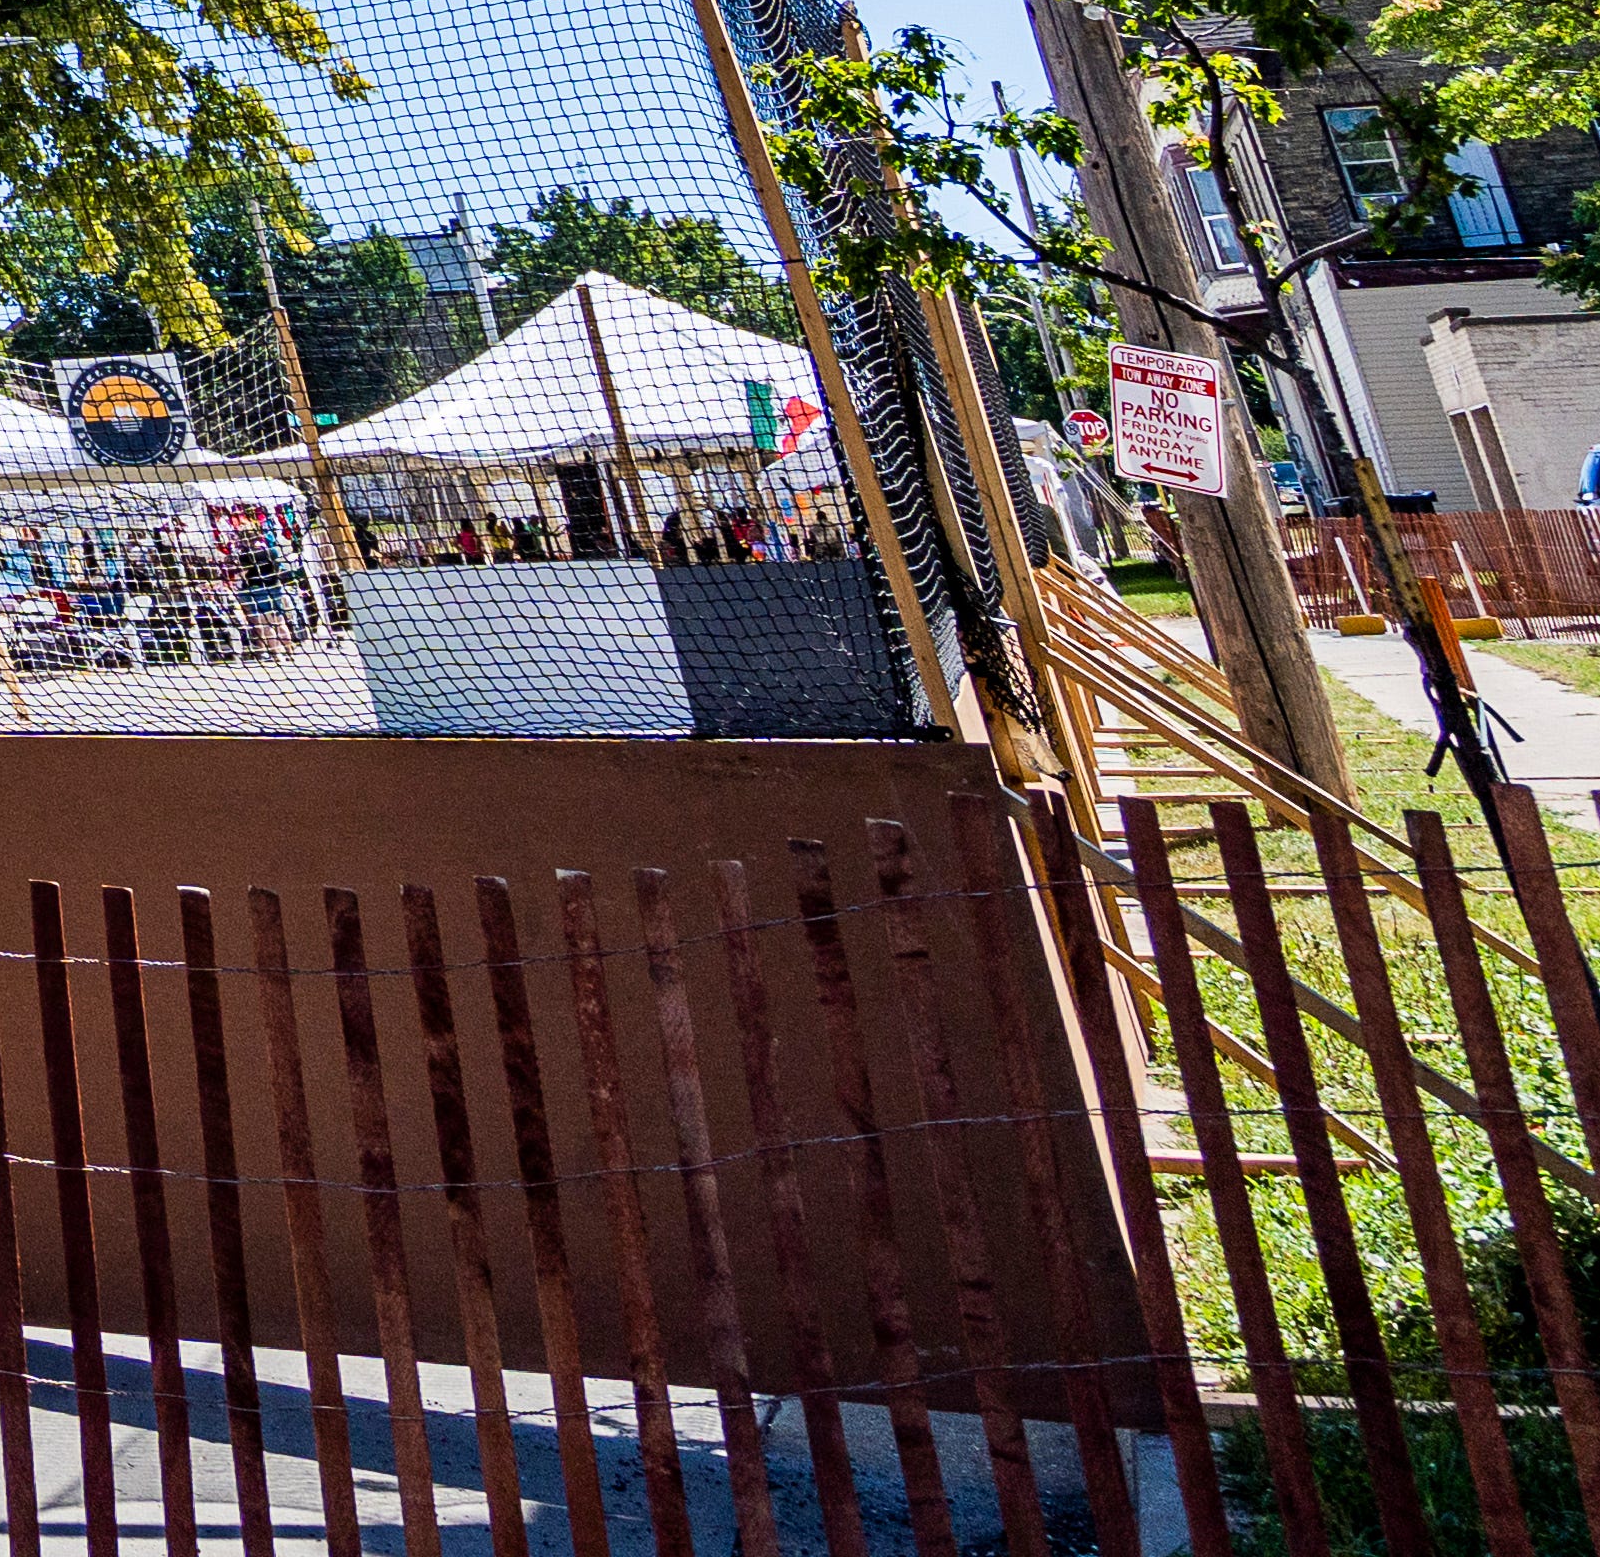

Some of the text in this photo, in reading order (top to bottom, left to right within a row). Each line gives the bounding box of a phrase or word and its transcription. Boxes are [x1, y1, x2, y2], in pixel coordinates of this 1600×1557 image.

[1119, 351, 1205, 376] TEMPORARY
[1120, 367, 1207, 395] TOW AWAY ZONE
[1151, 389, 1179, 408] NO
[1121, 401, 1212, 432] PARKING
[1122, 419, 1182, 439] FRIDAY
[1122, 431, 1194, 454] MONDAY
[1128, 444, 1204, 470] ANYTIME
